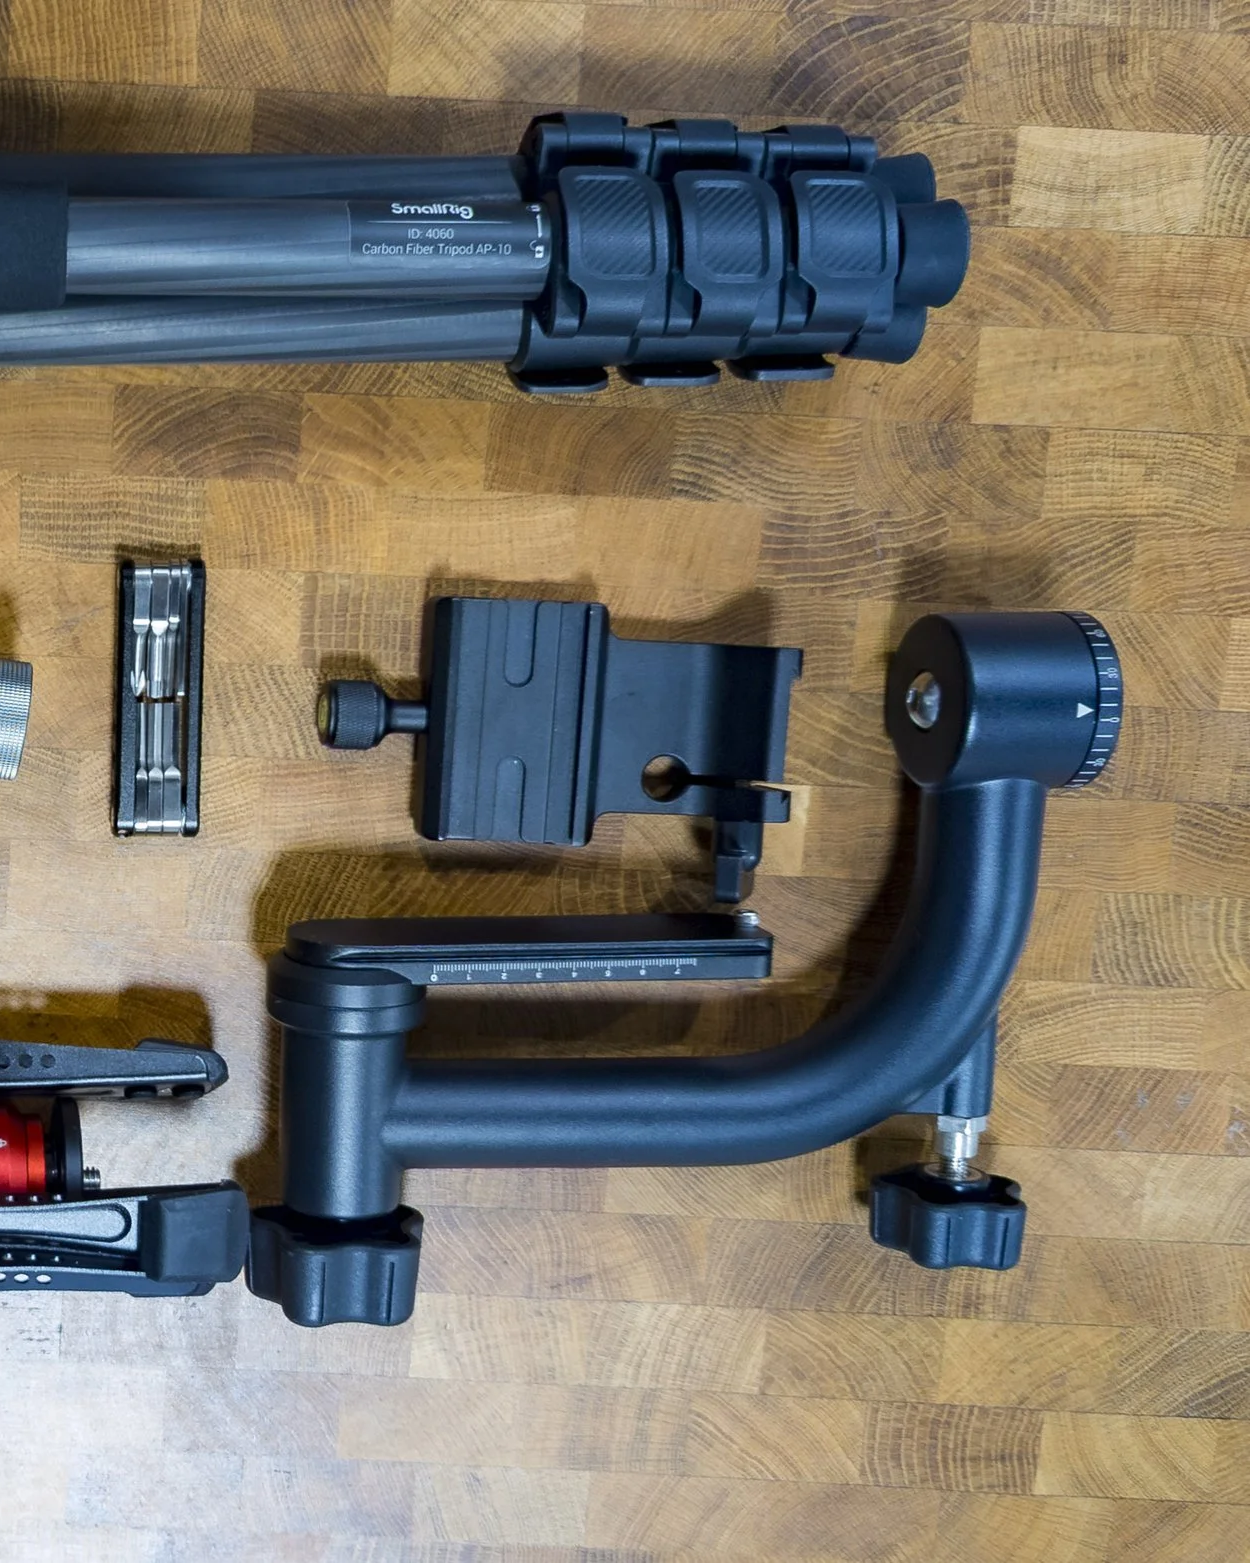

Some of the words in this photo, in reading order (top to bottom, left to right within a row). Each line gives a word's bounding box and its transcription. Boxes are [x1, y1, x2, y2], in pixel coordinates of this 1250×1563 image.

[391, 203, 474, 219] SmallRig
[407, 229, 422, 239] ID:
[425, 228, 455, 239] 4060
[362, 243, 403, 255] Carbon
[406, 243, 435, 255] Fiber
[437, 243, 474, 257] Tripod
[476, 243, 512, 255] AP-10
